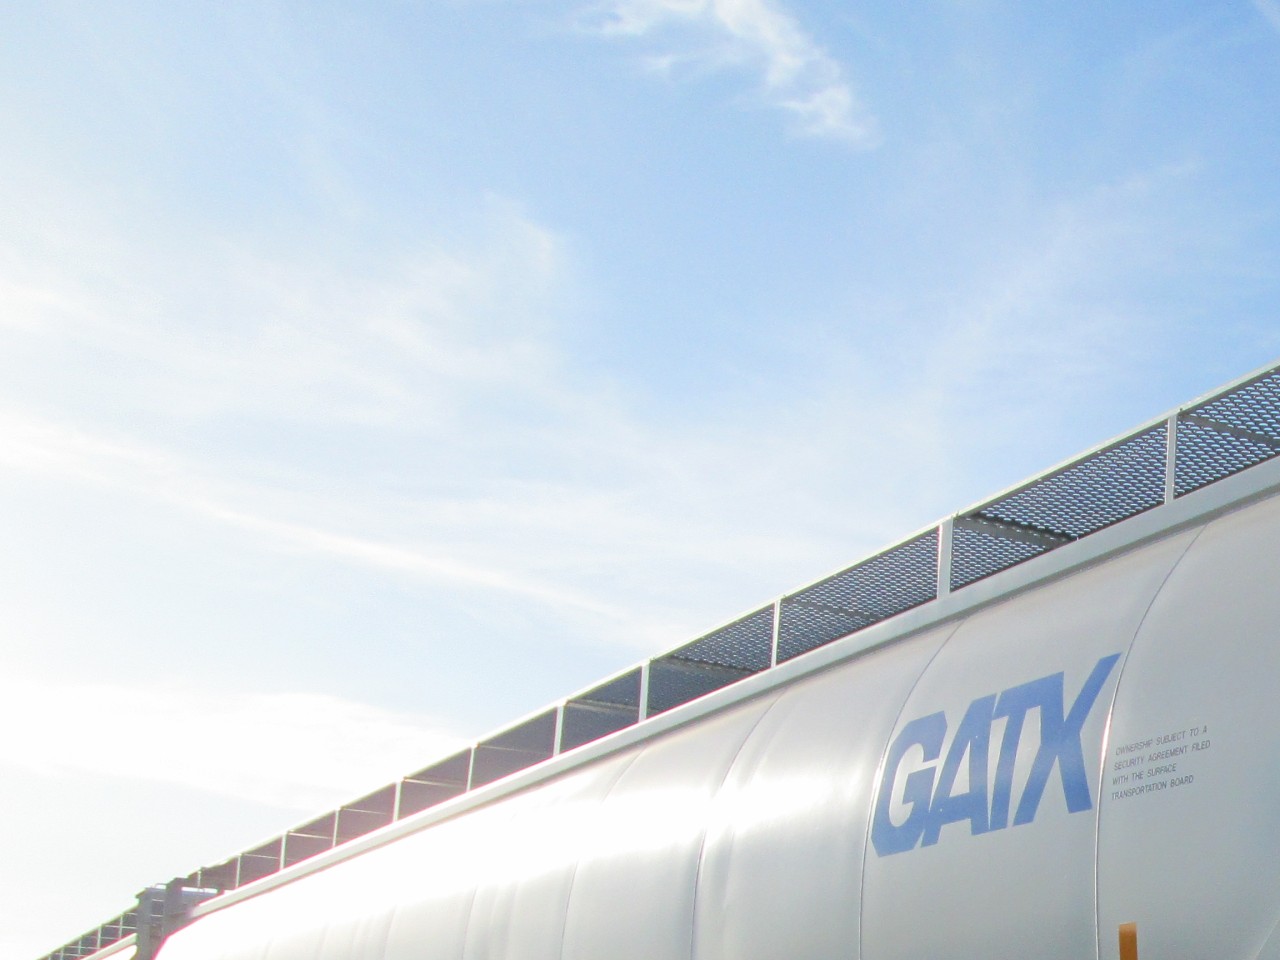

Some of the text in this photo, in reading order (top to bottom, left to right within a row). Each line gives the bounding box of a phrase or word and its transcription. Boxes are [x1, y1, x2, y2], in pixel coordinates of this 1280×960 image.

[871, 652, 1123, 858] GATX
[1114, 739, 1210, 771] SECURITY AGREEMENT FILED
[1115, 725, 1207, 756] OWNERSHIP SUBJECT TO A
[1111, 775, 1194, 800] TRANSPORTATION BOARD
[1112, 763, 1177, 785] WITH THE SURFACE
